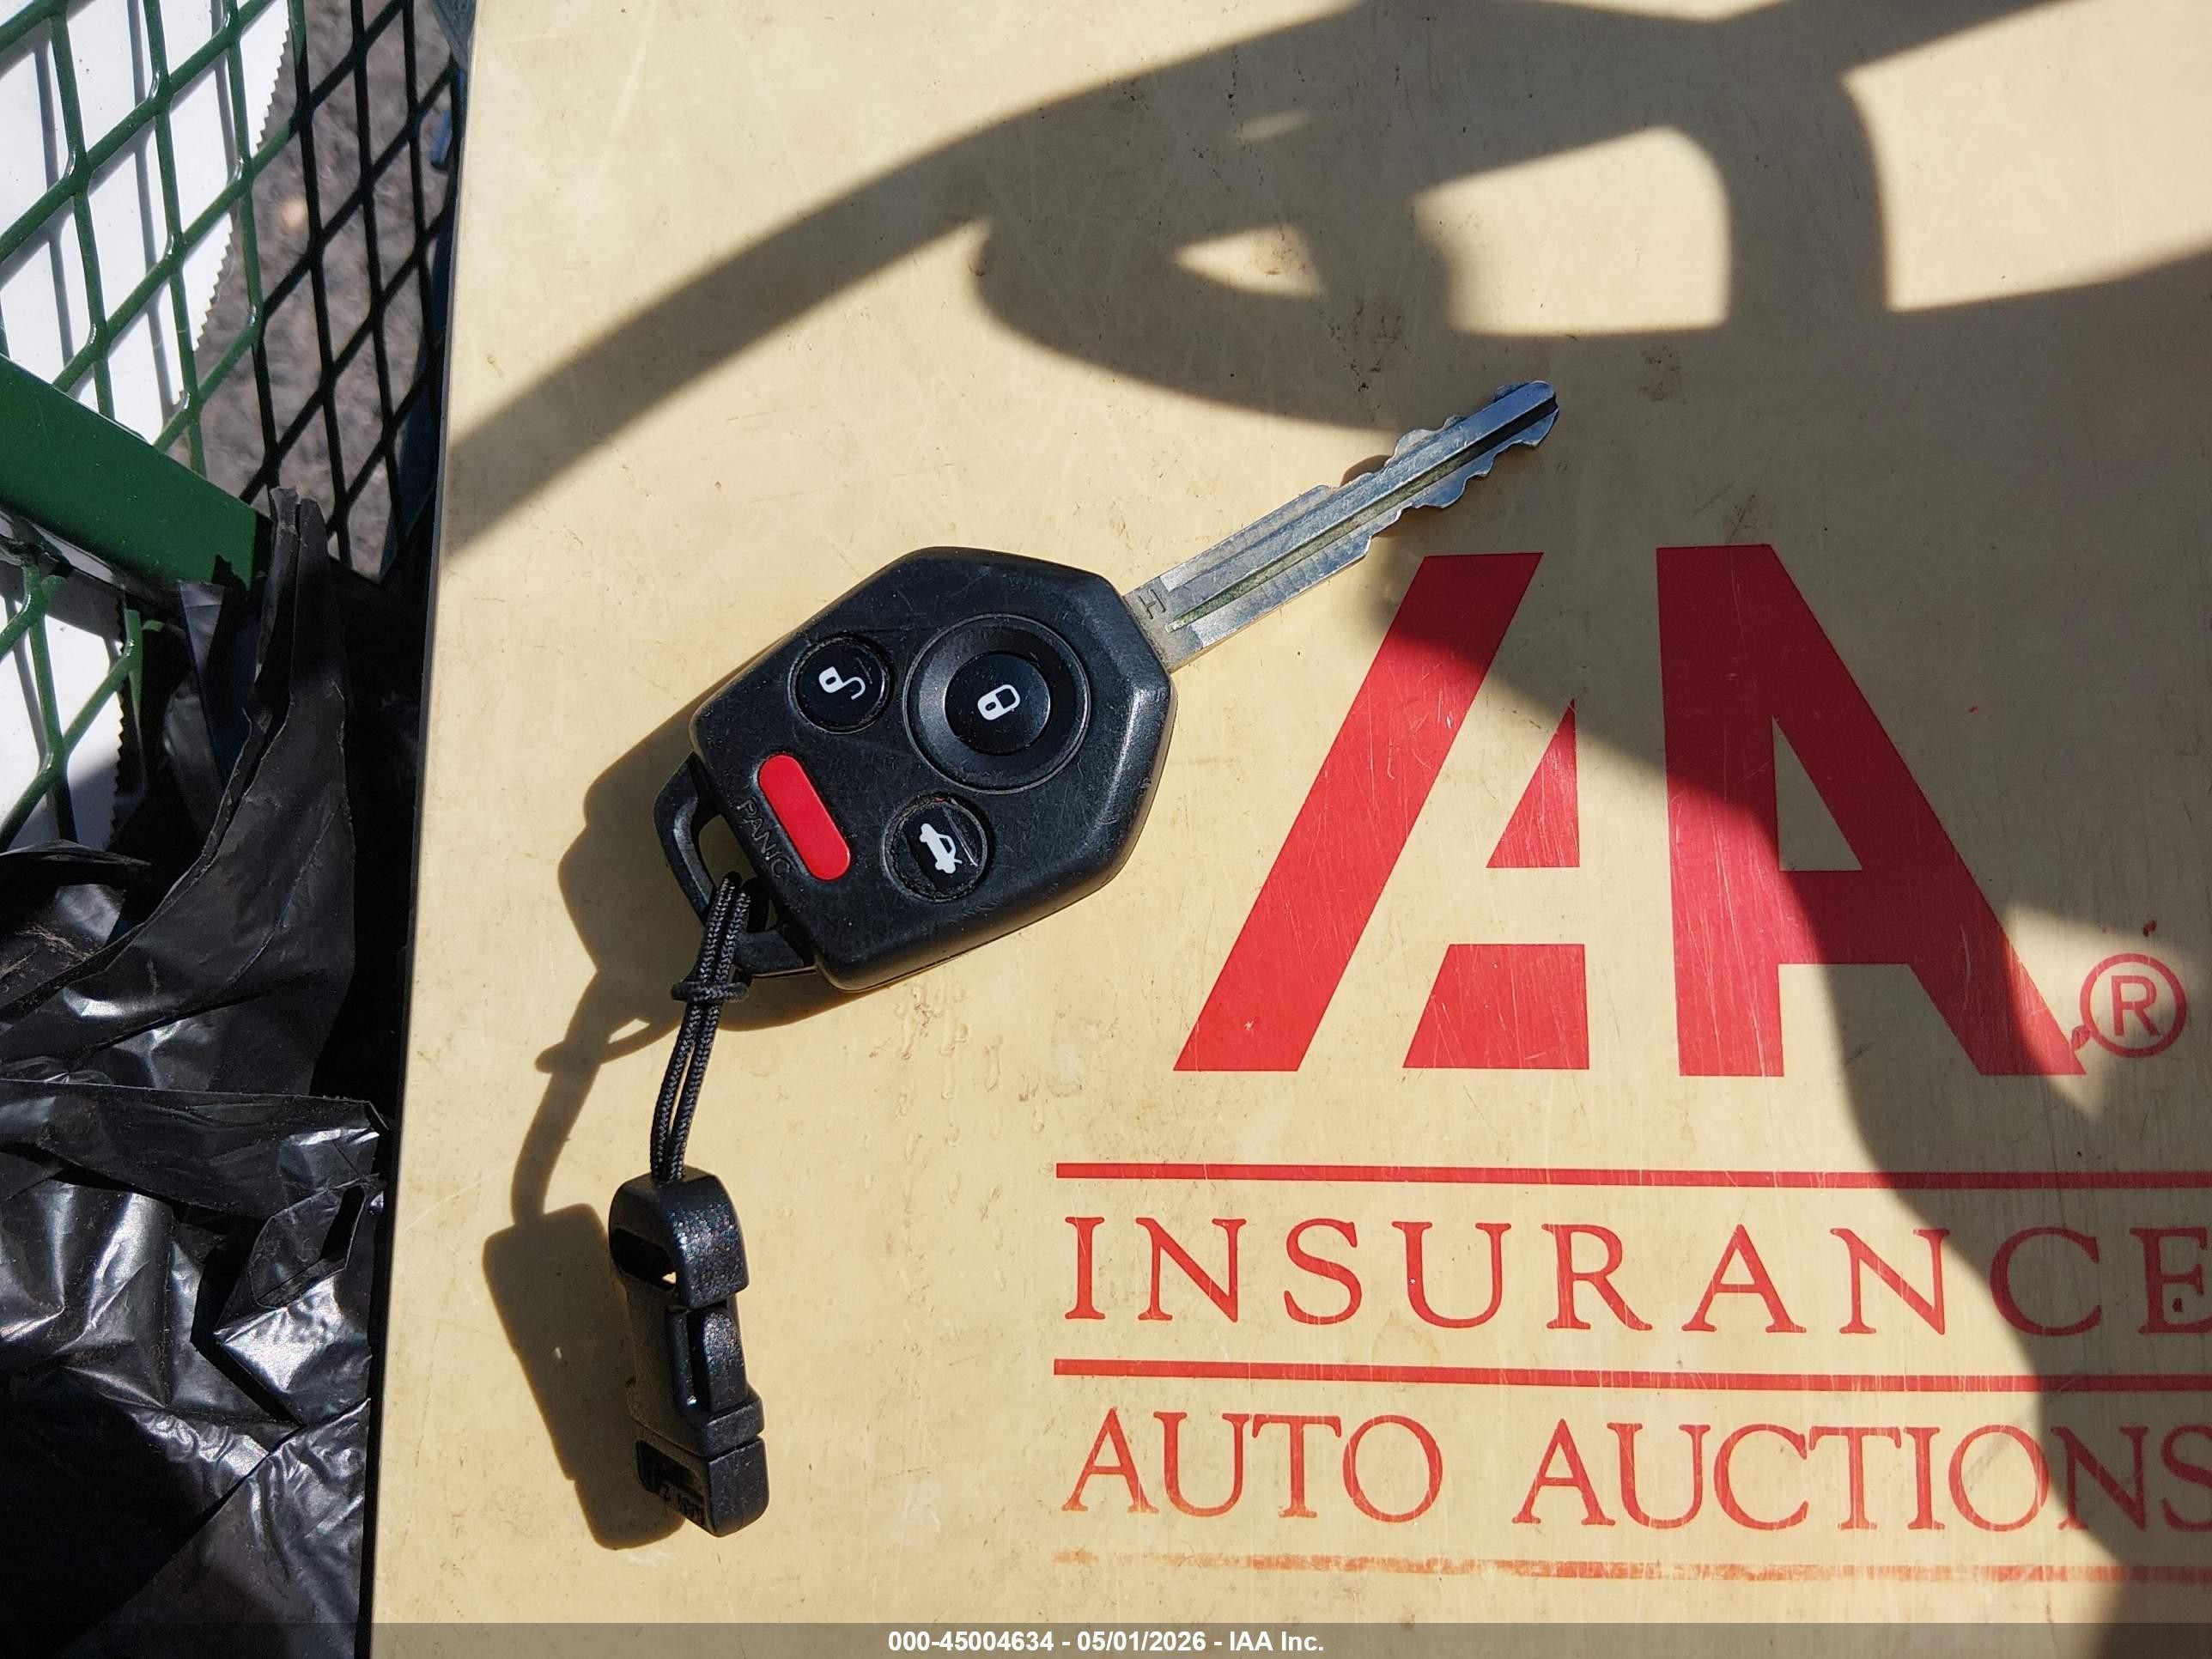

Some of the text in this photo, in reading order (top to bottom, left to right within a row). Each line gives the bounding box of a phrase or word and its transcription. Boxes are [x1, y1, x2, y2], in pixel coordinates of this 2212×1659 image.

[737, 797, 792, 878] PANIC
[1064, 1216, 2212, 1337] INSURANCE
[1063, 1407, 2212, 1533] AUTO AUCTIONS
